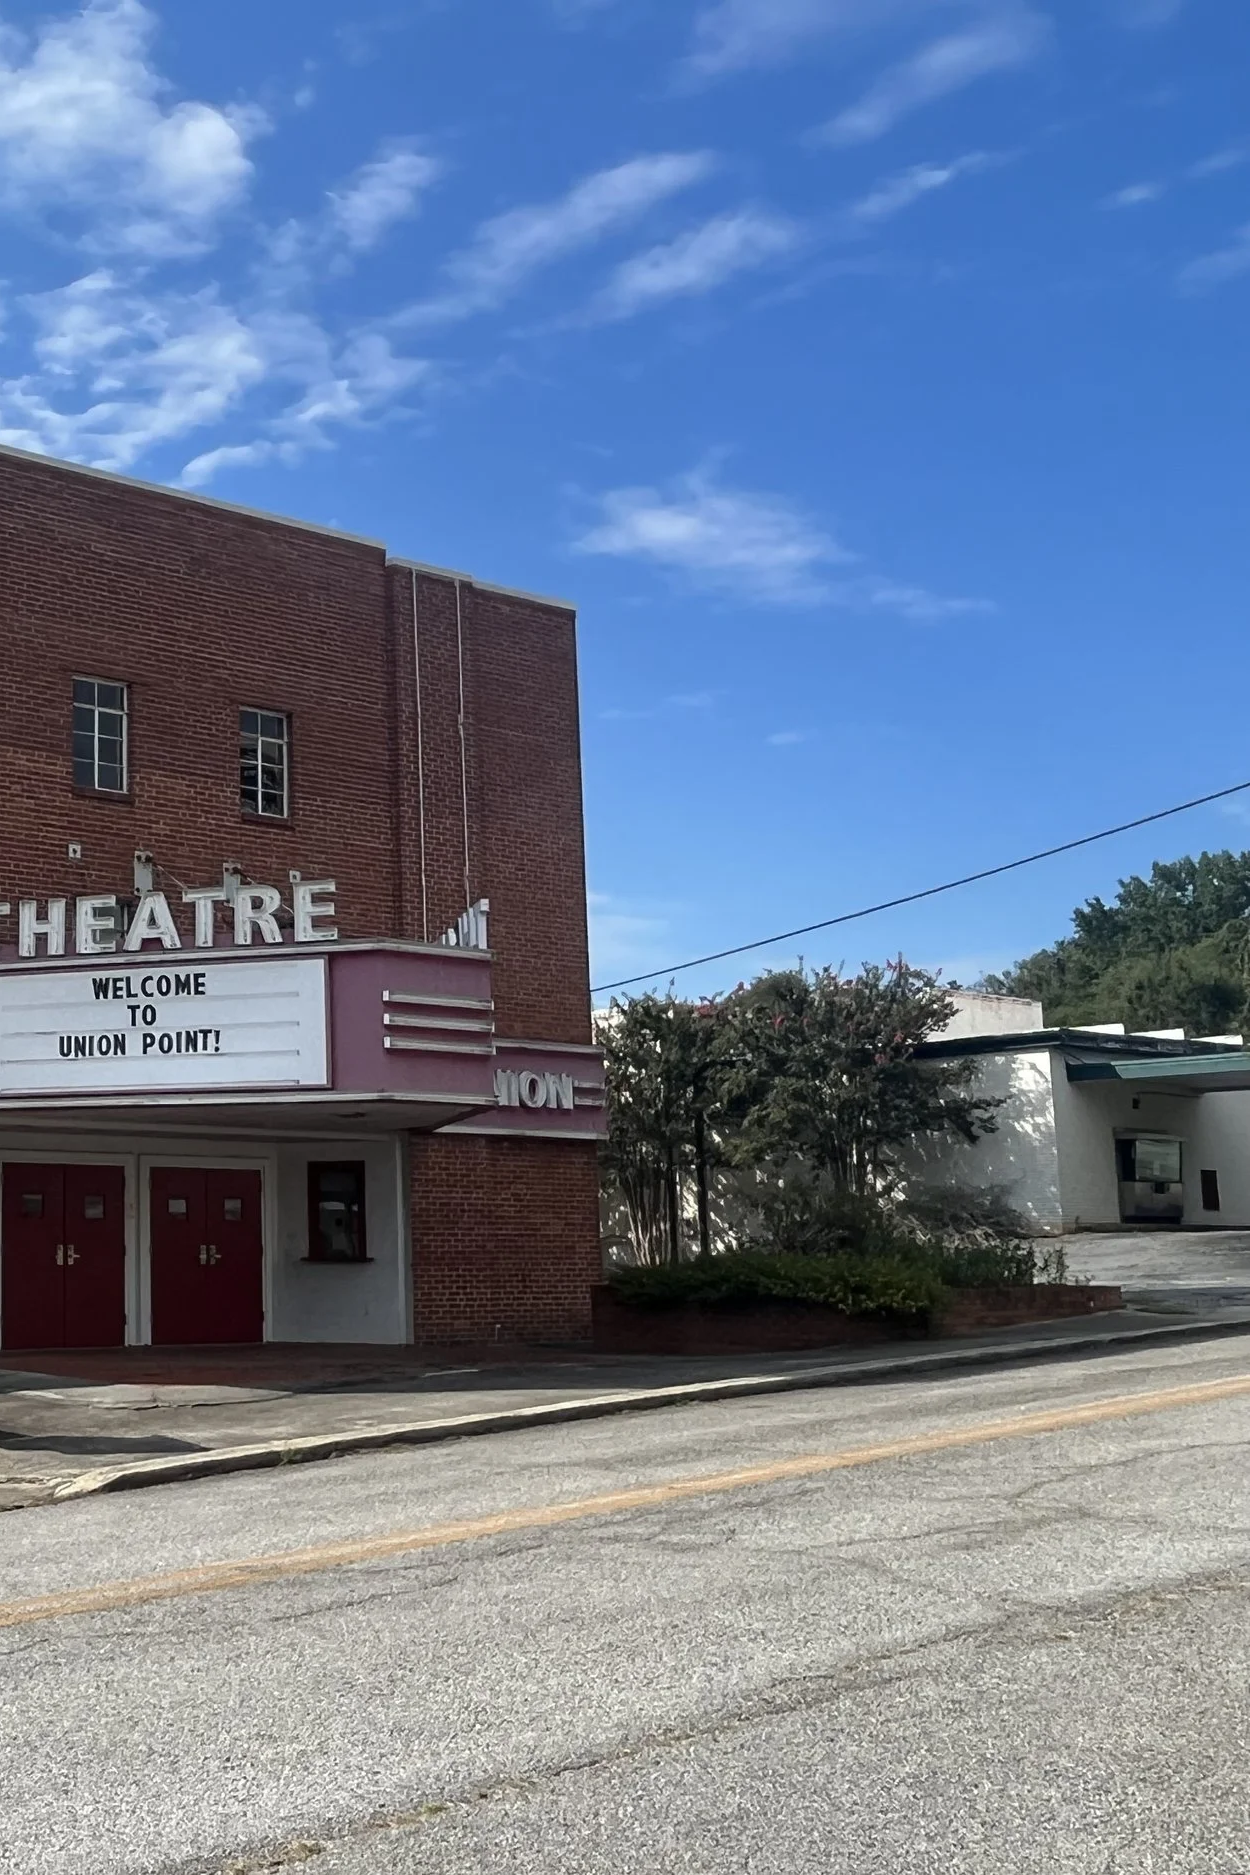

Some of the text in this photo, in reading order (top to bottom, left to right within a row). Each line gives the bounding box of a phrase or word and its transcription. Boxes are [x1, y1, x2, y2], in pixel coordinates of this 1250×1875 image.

[91, 972, 207, 1000] WELCOME
[126, 1004, 157, 1027] TO
[58, 1029, 221, 1058] UNION POINT!
